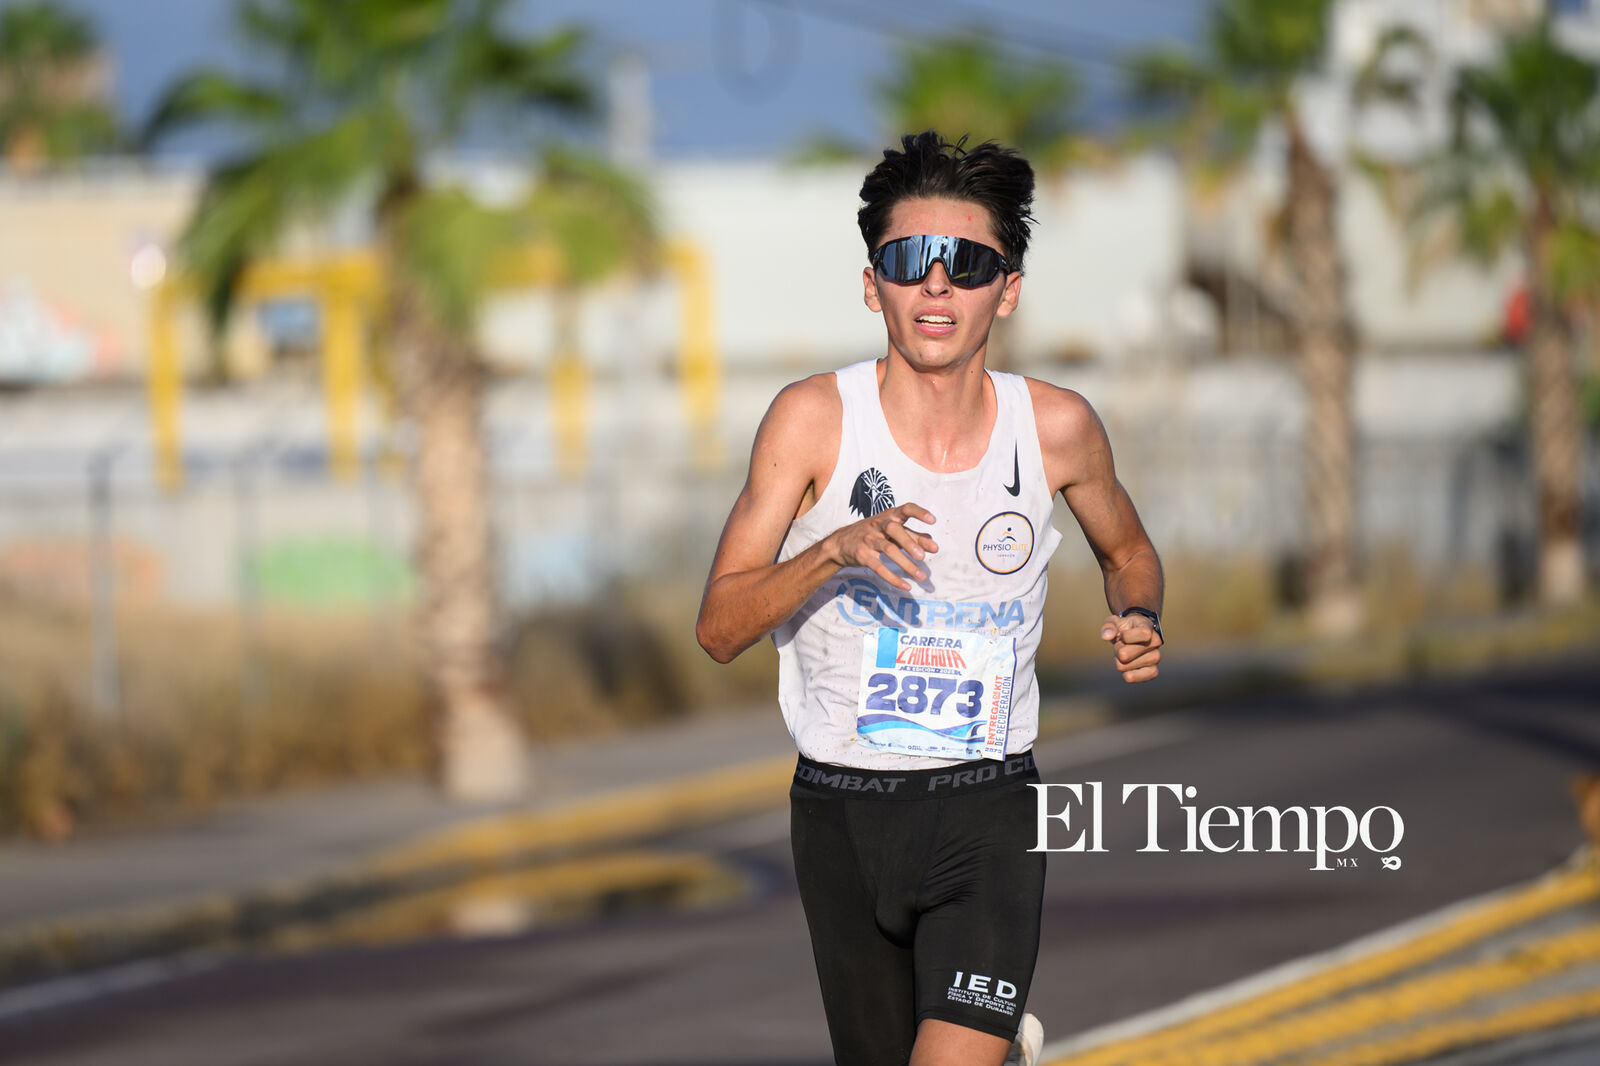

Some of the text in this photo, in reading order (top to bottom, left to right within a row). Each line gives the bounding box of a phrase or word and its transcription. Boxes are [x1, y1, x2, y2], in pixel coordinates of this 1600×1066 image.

[900, 634, 963, 649] CARRERA
[895, 646, 968, 670] CHILCHOTA
[865, 672, 985, 719] 2873
[986, 700, 1000, 746] ENTREGA
[993, 675, 1004, 691] KIT
[994, 736, 1004, 747] DE
[927, 764, 998, 792] PRO
[953, 971, 1017, 999] IED
[947, 995, 972, 1004] ESTADO
[985, 1003, 1014, 1016] DURANGO
[948, 987, 980, 997] INSTITUTO
[993, 996, 1016, 1008] CULTURA
[975, 997, 1005, 1008] DEPORTE
